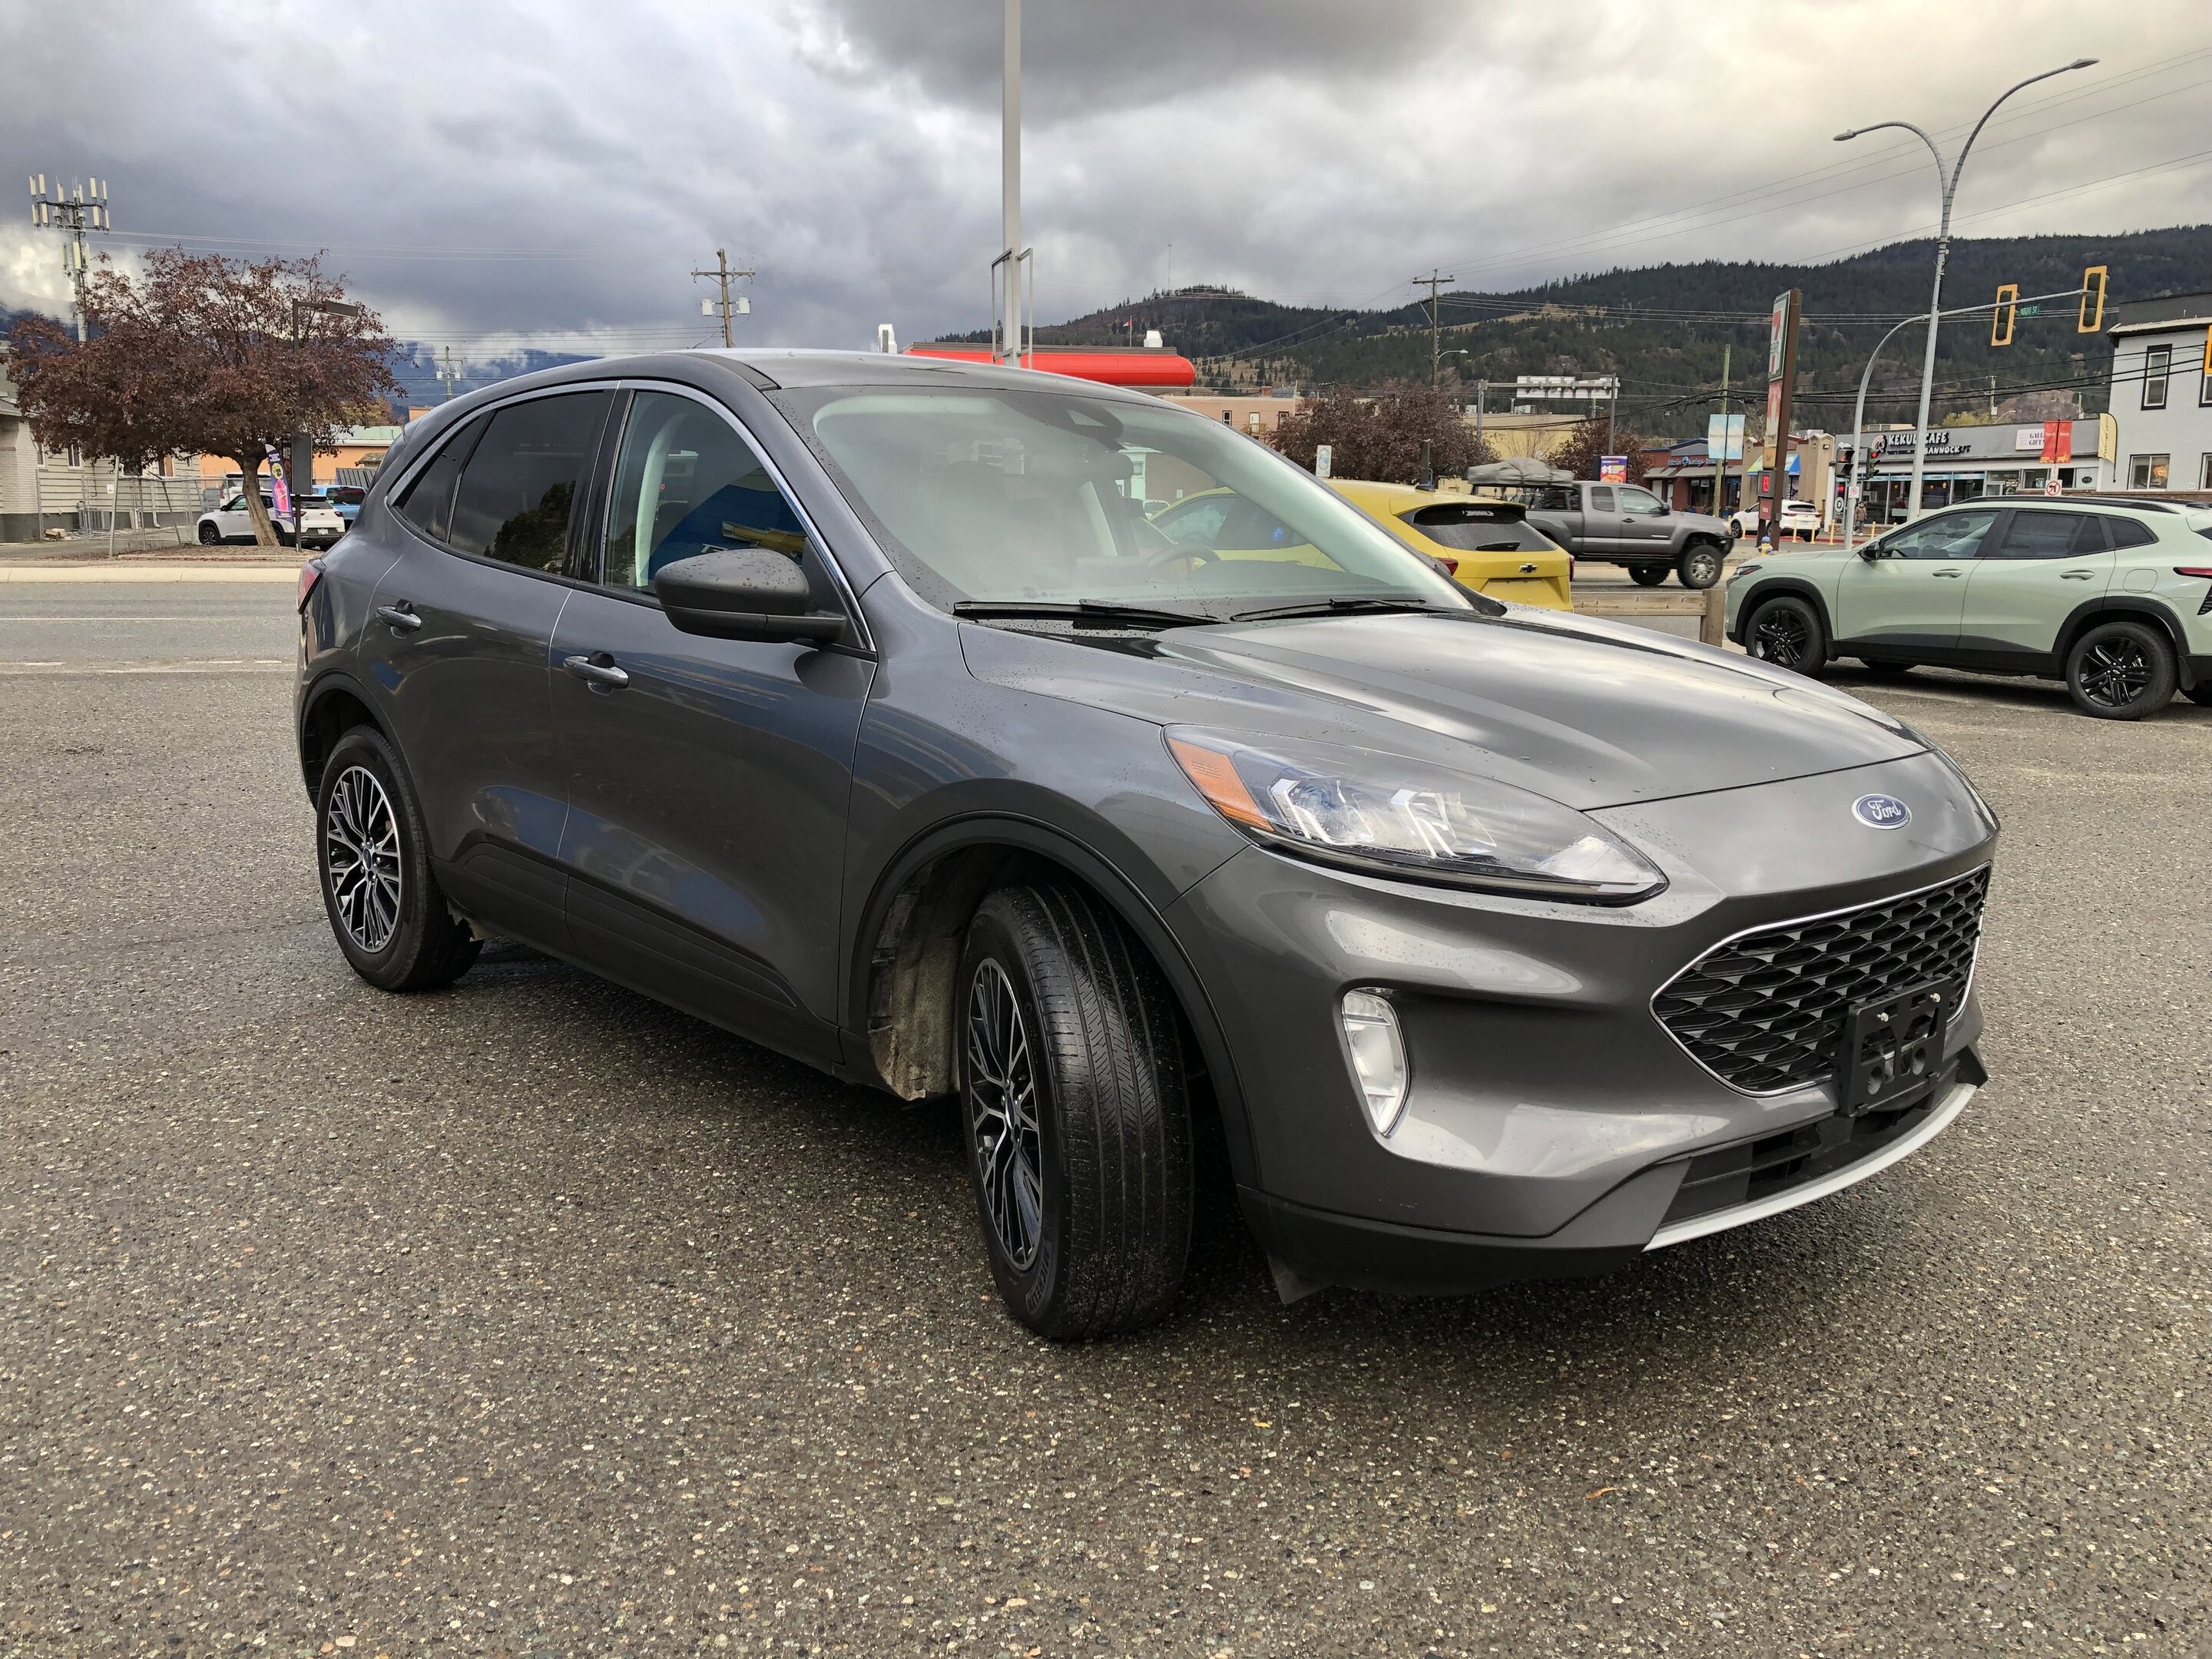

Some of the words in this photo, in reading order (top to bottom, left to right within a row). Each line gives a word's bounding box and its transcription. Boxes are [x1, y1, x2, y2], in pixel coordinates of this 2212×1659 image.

[2032, 305, 2038, 314] ST
[1888, 433, 1917, 445] KEKUL
[1923, 445, 1960, 455] BANNOCK
[1867, 799, 1902, 820] Ford
